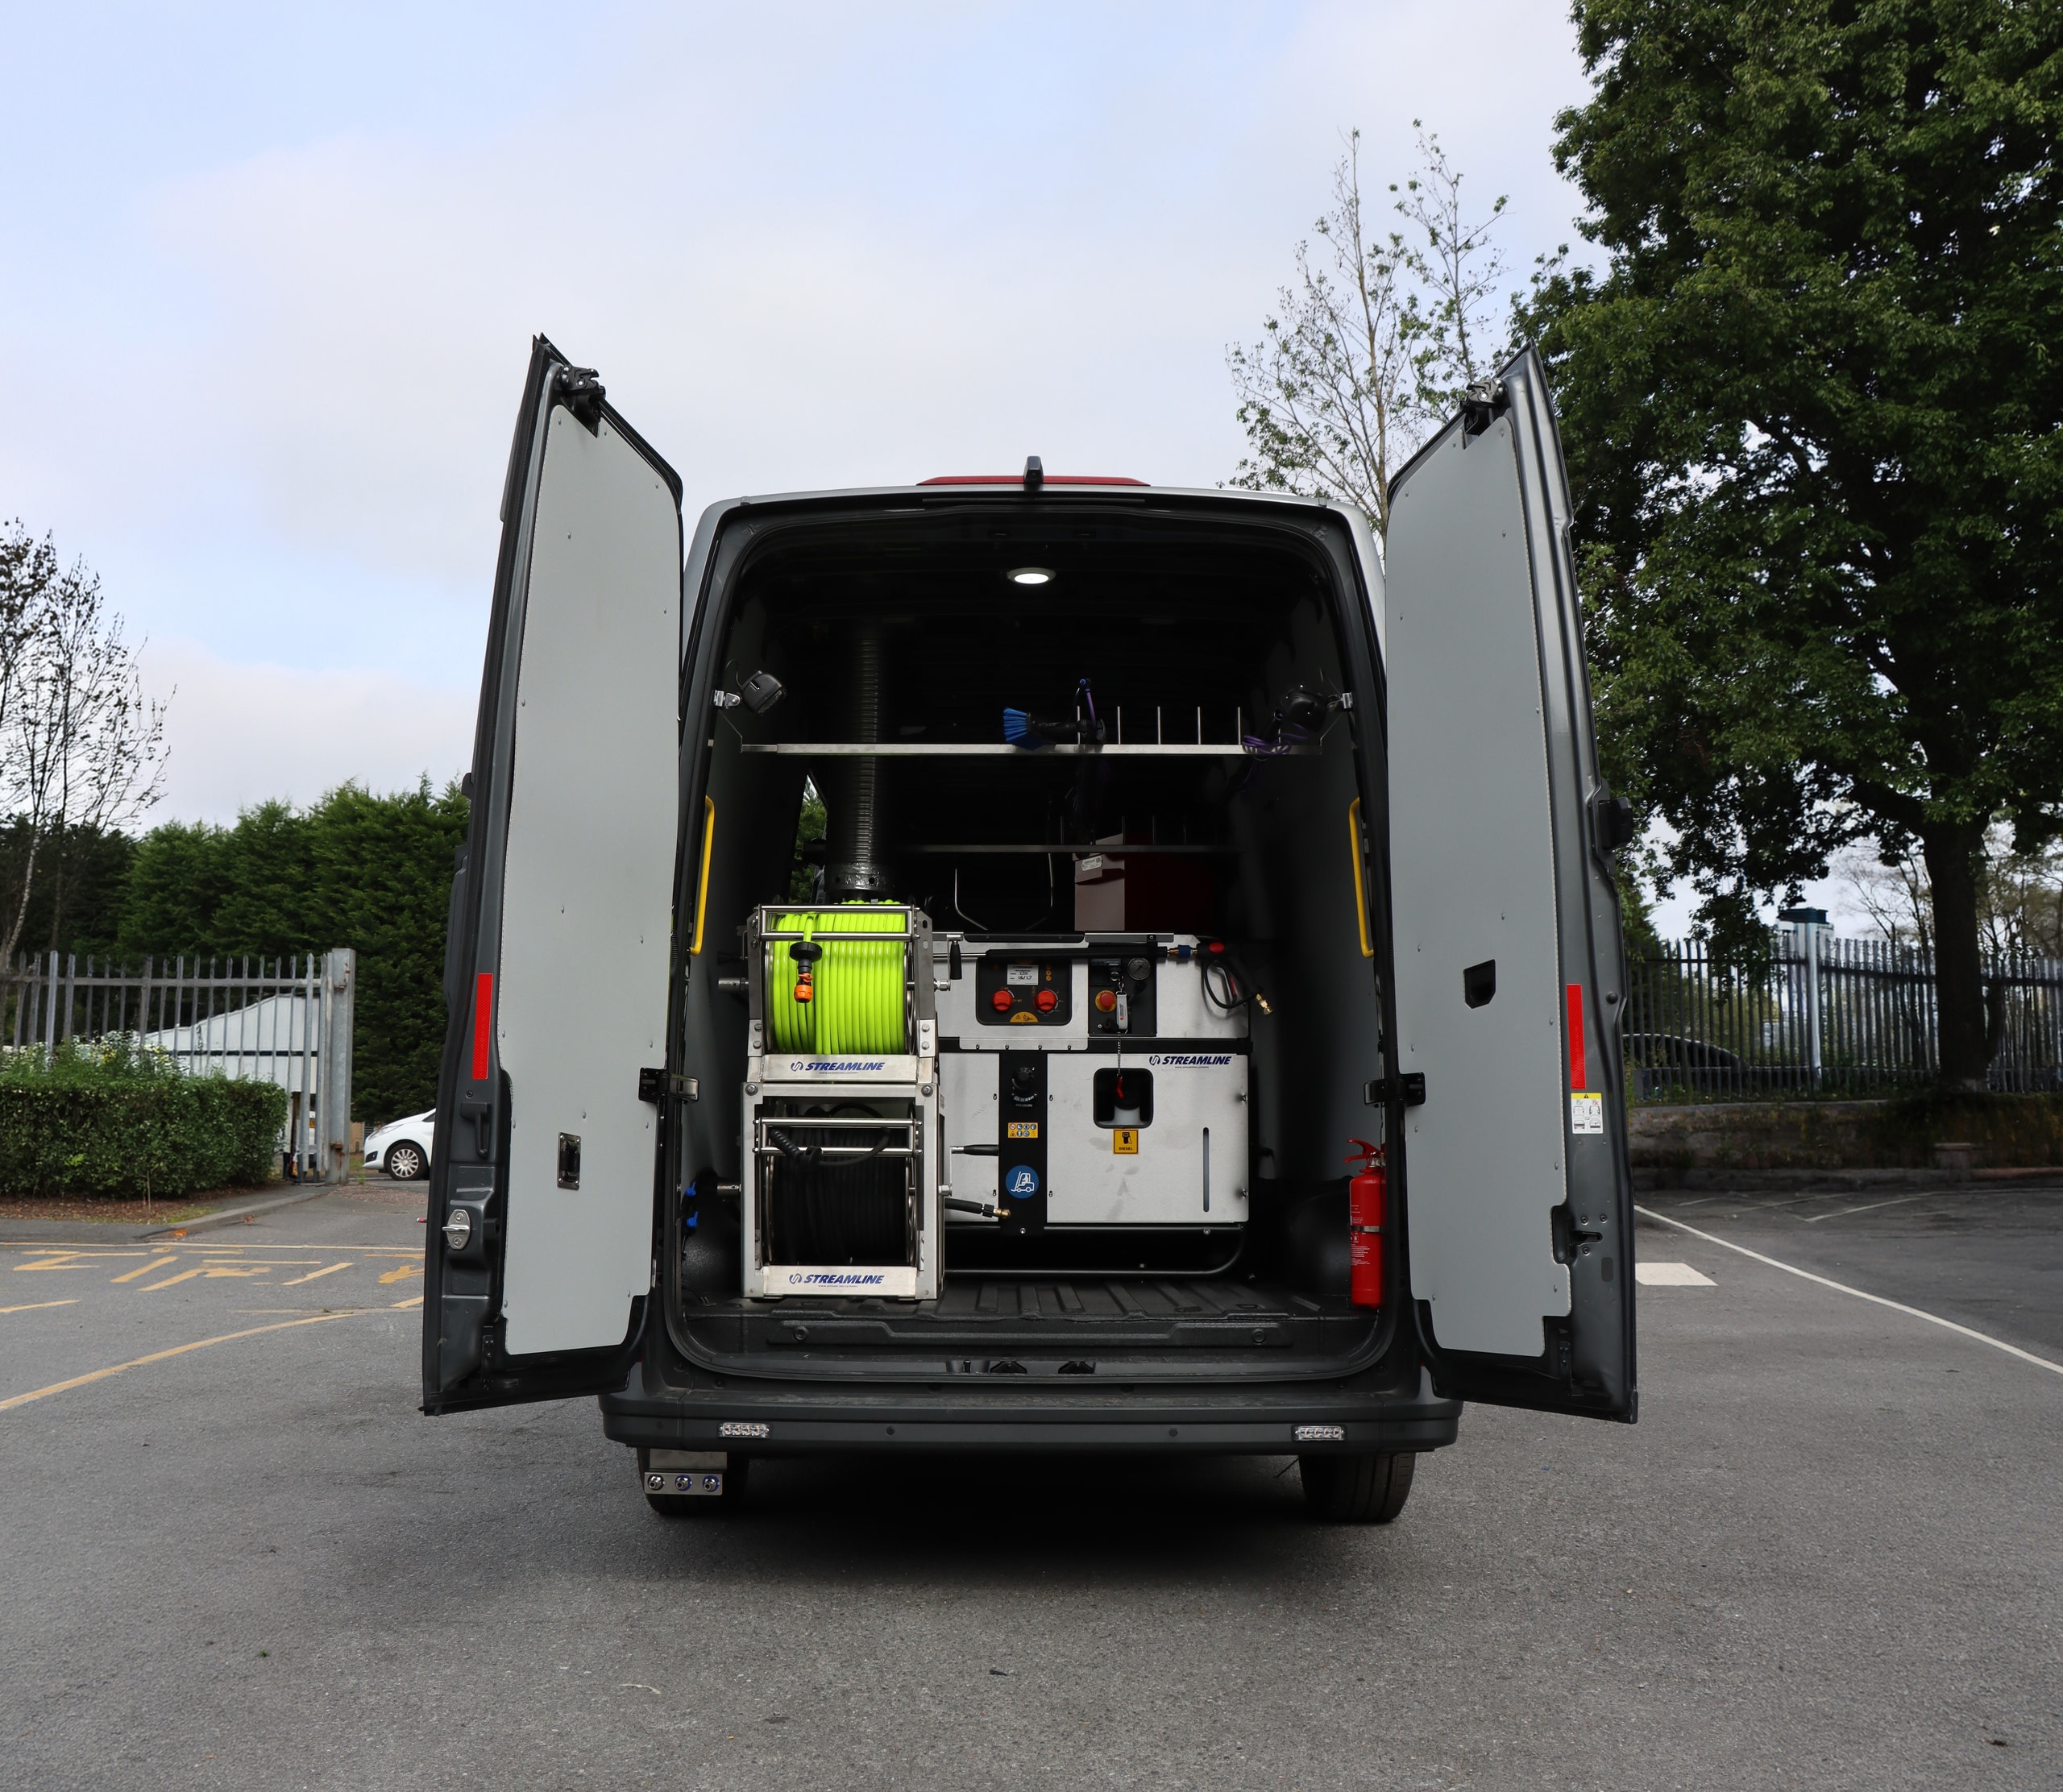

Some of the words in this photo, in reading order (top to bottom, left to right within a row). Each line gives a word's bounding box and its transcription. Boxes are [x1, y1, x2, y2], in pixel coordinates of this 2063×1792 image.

[1161, 1056, 1232, 1065] STREAMLINE
[805, 1062, 885, 1071] STREAMLINE
[803, 1274, 885, 1284] STREAMLINE
